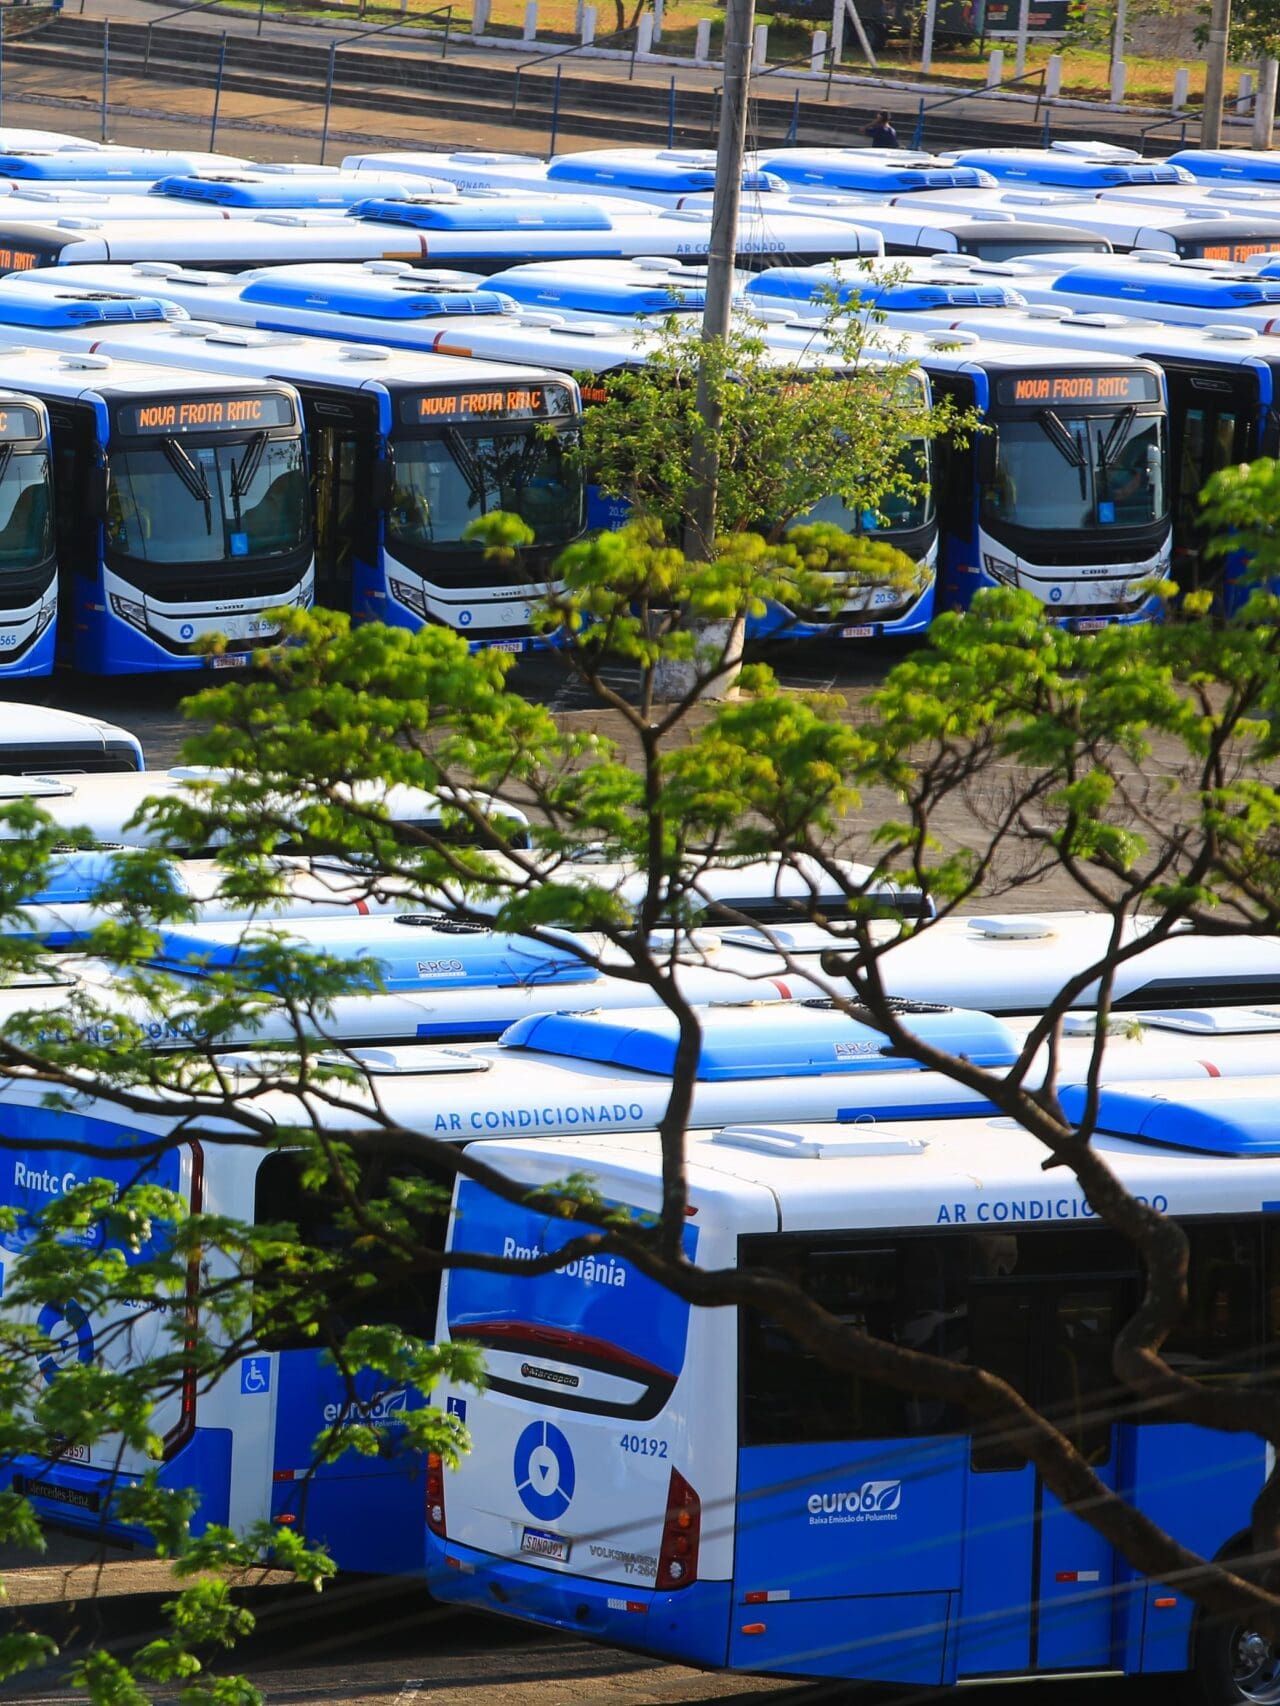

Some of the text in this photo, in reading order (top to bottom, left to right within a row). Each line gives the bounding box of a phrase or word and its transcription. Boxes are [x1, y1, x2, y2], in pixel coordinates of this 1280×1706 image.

[676, 243, 692, 253] AR
[13, 250, 36, 270] RMTC
[1016, 376, 1129, 399] NOVA FROTA RMTC
[139, 400, 262, 427] NOVA FROTA RMTC
[421, 391, 541, 415] NOVA FROTA RMTC
[417, 959, 463, 972] ARCO
[434, 1103, 644, 1131] AR CONDICIONADO
[14, 1162, 59, 1194] Rmtc
[937, 1203, 967, 1224] AR
[529, 1367, 578, 1386] Marcopolo
[620, 1434, 668, 1458] 40192
[807, 1484, 876, 1514] euro6
[809, 1513, 898, 1525] Baixa Emissão de Poluentes
